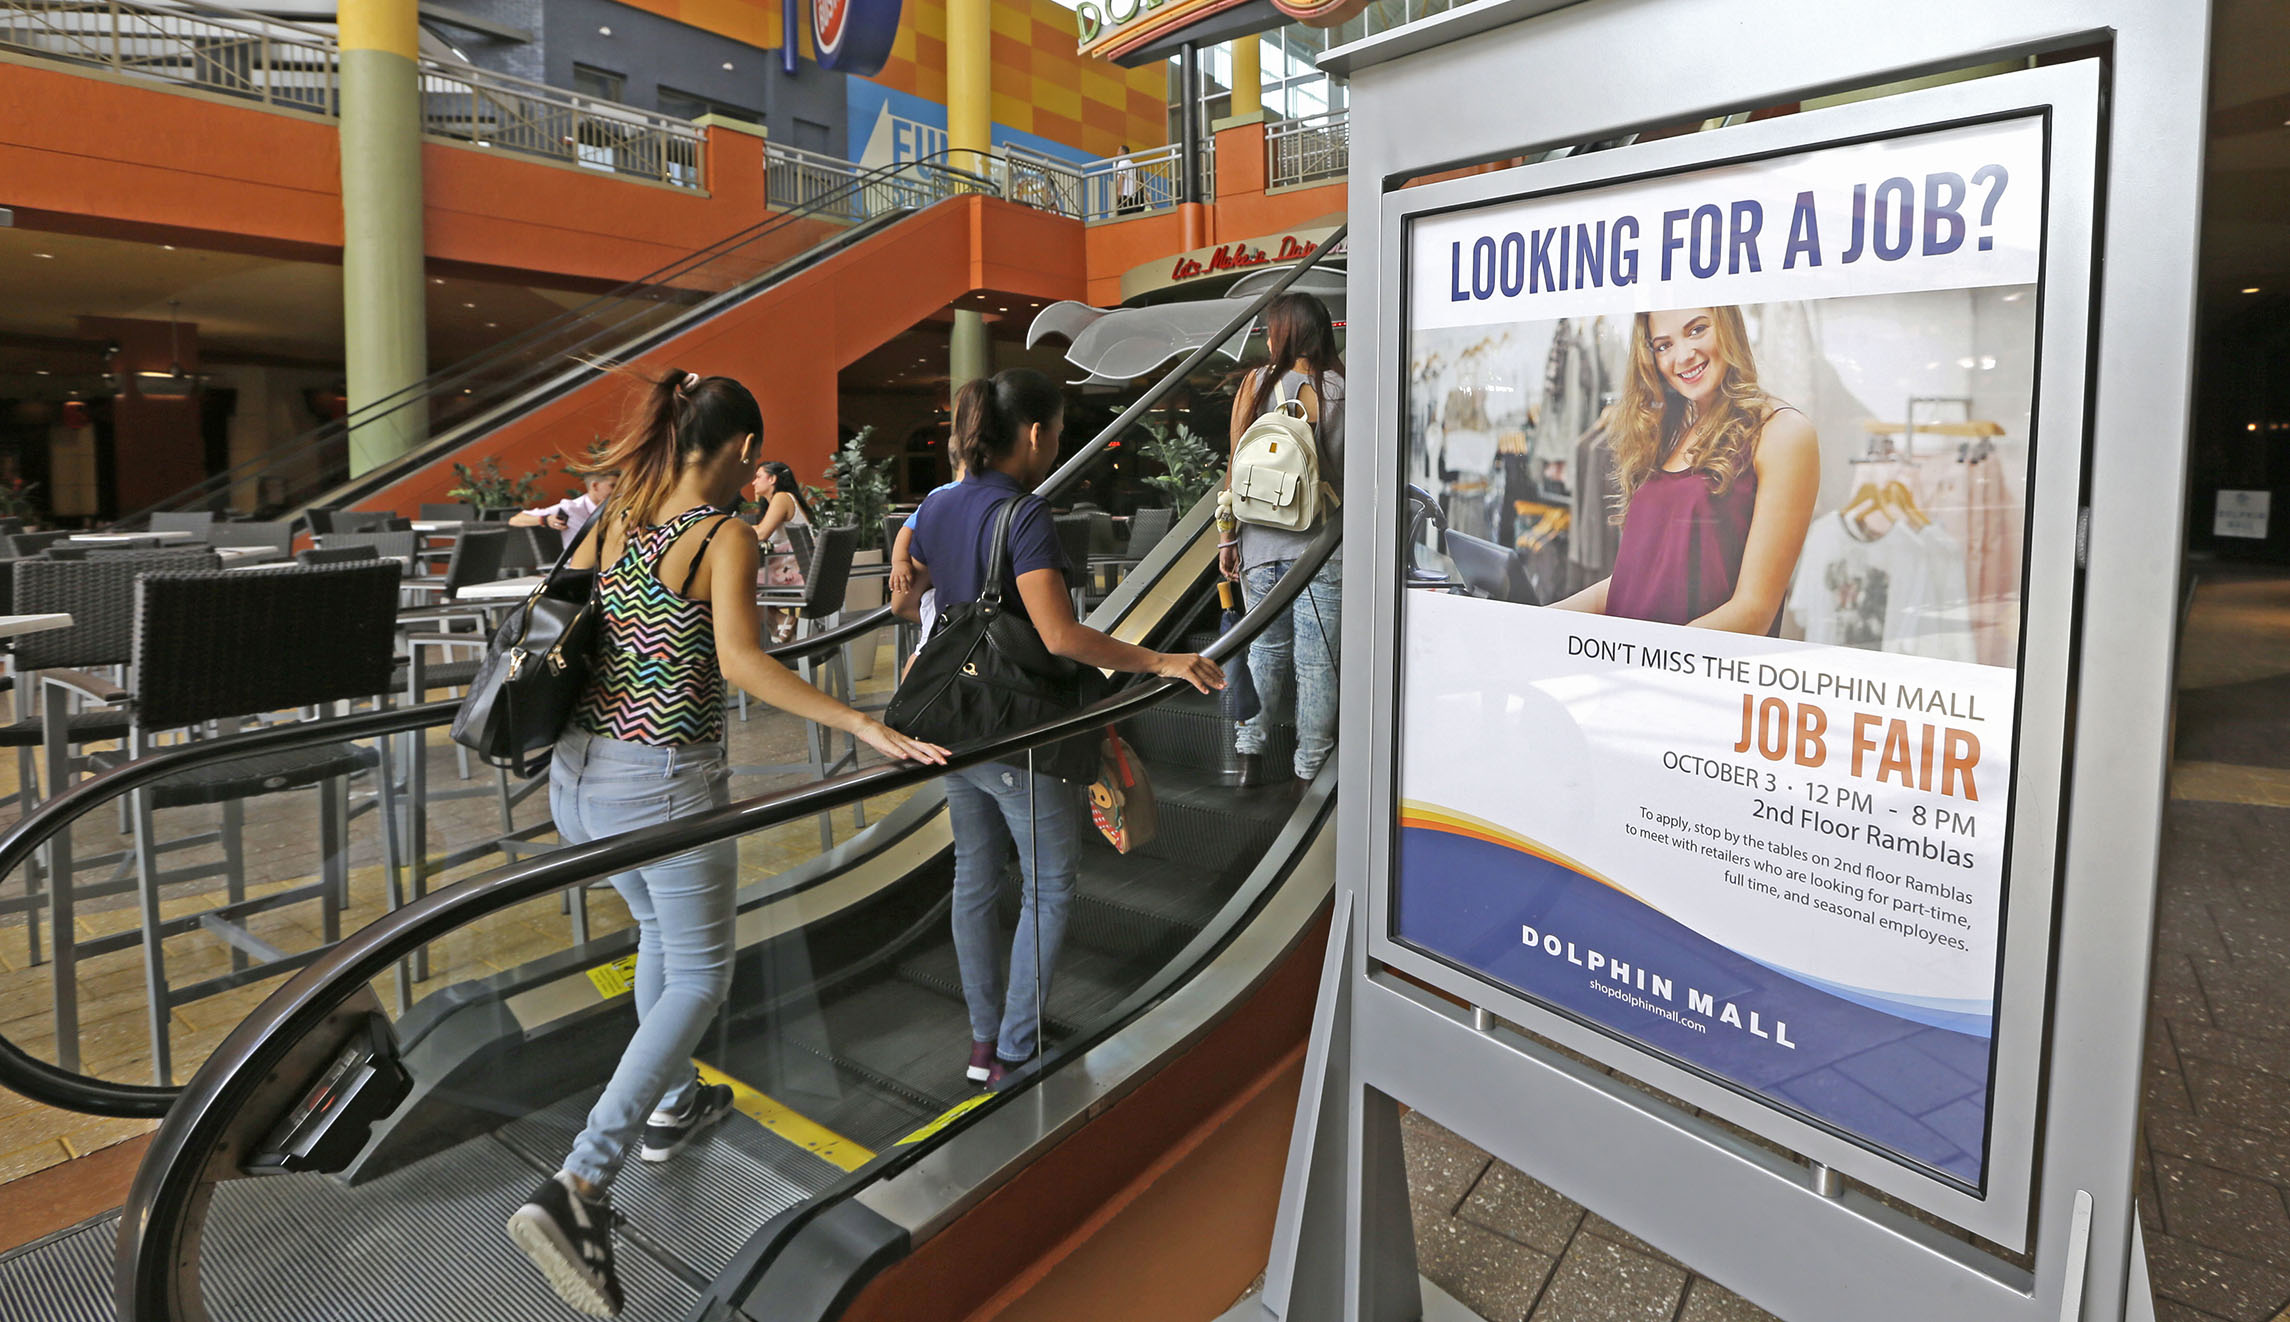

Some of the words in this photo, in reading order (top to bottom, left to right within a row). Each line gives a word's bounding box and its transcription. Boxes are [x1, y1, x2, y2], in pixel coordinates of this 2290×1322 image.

[1076, 0, 1163, 44] DO
[1450, 215, 1641, 302] LOOKING
[1660, 198, 1765, 282] FOR
[1782, 190, 1823, 270] A
[1841, 163, 2010, 265] JOB?
[1567, 634, 1637, 665] DON'T
[1640, 647, 1697, 675] MISS
[1702, 655, 1751, 685] THE
[1757, 664, 1888, 706] DOLPHIN
[1896, 684, 1987, 722] MALL
[1733, 692, 1828, 769] JOB
[1850, 711, 1982, 803] FAIR
[1662, 750, 1759, 791] OCTOBER
[1764, 773, 1777, 793] 3
[1805, 782, 1829, 805] 12
[1836, 788, 1874, 815] PM
[1911, 805, 1928, 826] 8
[1934, 808, 1976, 838] PM
[1752, 799, 1794, 826] 2nd
[1800, 809, 1861, 843] Floor
[1866, 824, 1975, 870] Ramblas
[1625, 823, 1638, 836] to
[1639, 828, 1670, 846] meet
[1671, 837, 1699, 853] with
[1700, 845, 1751, 868] retailers
[1753, 860, 1783, 877] who
[1785, 868, 1808, 884] are
[1810, 872, 1865, 901] looking
[1867, 887, 1890, 905] for
[1892, 898, 1972, 931] part-time,
[1639, 806, 1654, 821] To
[1655, 815, 1692, 833] apply,
[1694, 823, 1722, 840] stop
[1724, 828, 1741, 846] by
[1742, 834, 1765, 850] the
[1767, 840, 1809, 863] tables
[1811, 854, 1830, 868] on
[1833, 857, 1862, 876] 2nd
[1865, 864, 1902, 886] floor
[1905, 875, 1974, 905] Ramblas
[1724, 870, 1745, 887] full
[1747, 877, 1781, 900] time,
[1783, 889, 1811, 907] and
[1813, 898, 1876, 925] seasonal
[1878, 917, 1970, 952] employees.
[1521, 924, 1673, 1002] DOLPHIN
[1687, 987, 1797, 1050] MALL
[1589, 978, 1707, 1034] shopdolphinmall.com
